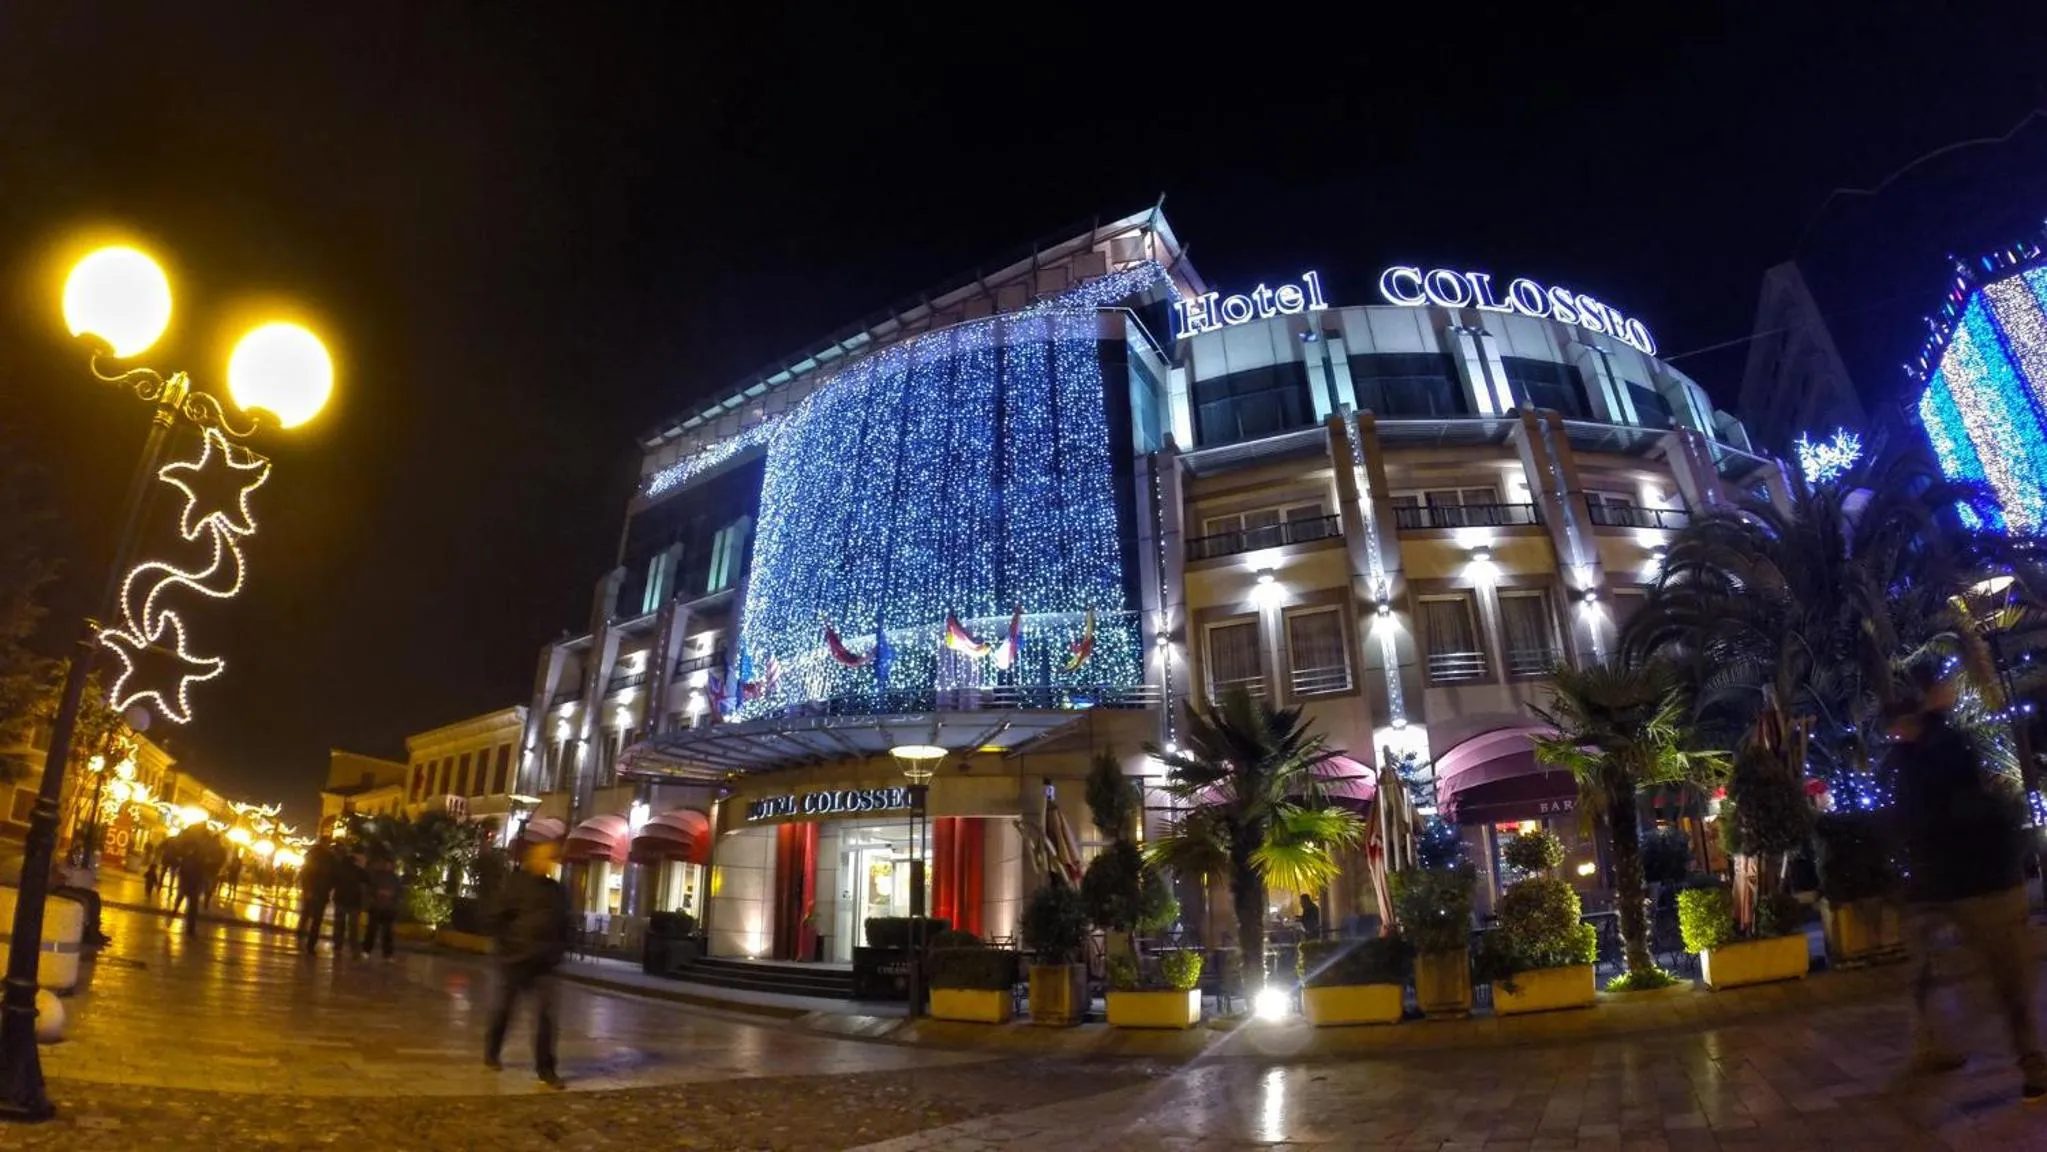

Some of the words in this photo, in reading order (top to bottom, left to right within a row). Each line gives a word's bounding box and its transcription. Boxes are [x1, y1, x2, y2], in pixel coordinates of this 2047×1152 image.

[1175, 270, 1328, 339] Hotel
[1379, 266, 1656, 356] COLOSSEO
[1539, 800, 1574, 813] BAR
[105, 827, 129, 848] 50
